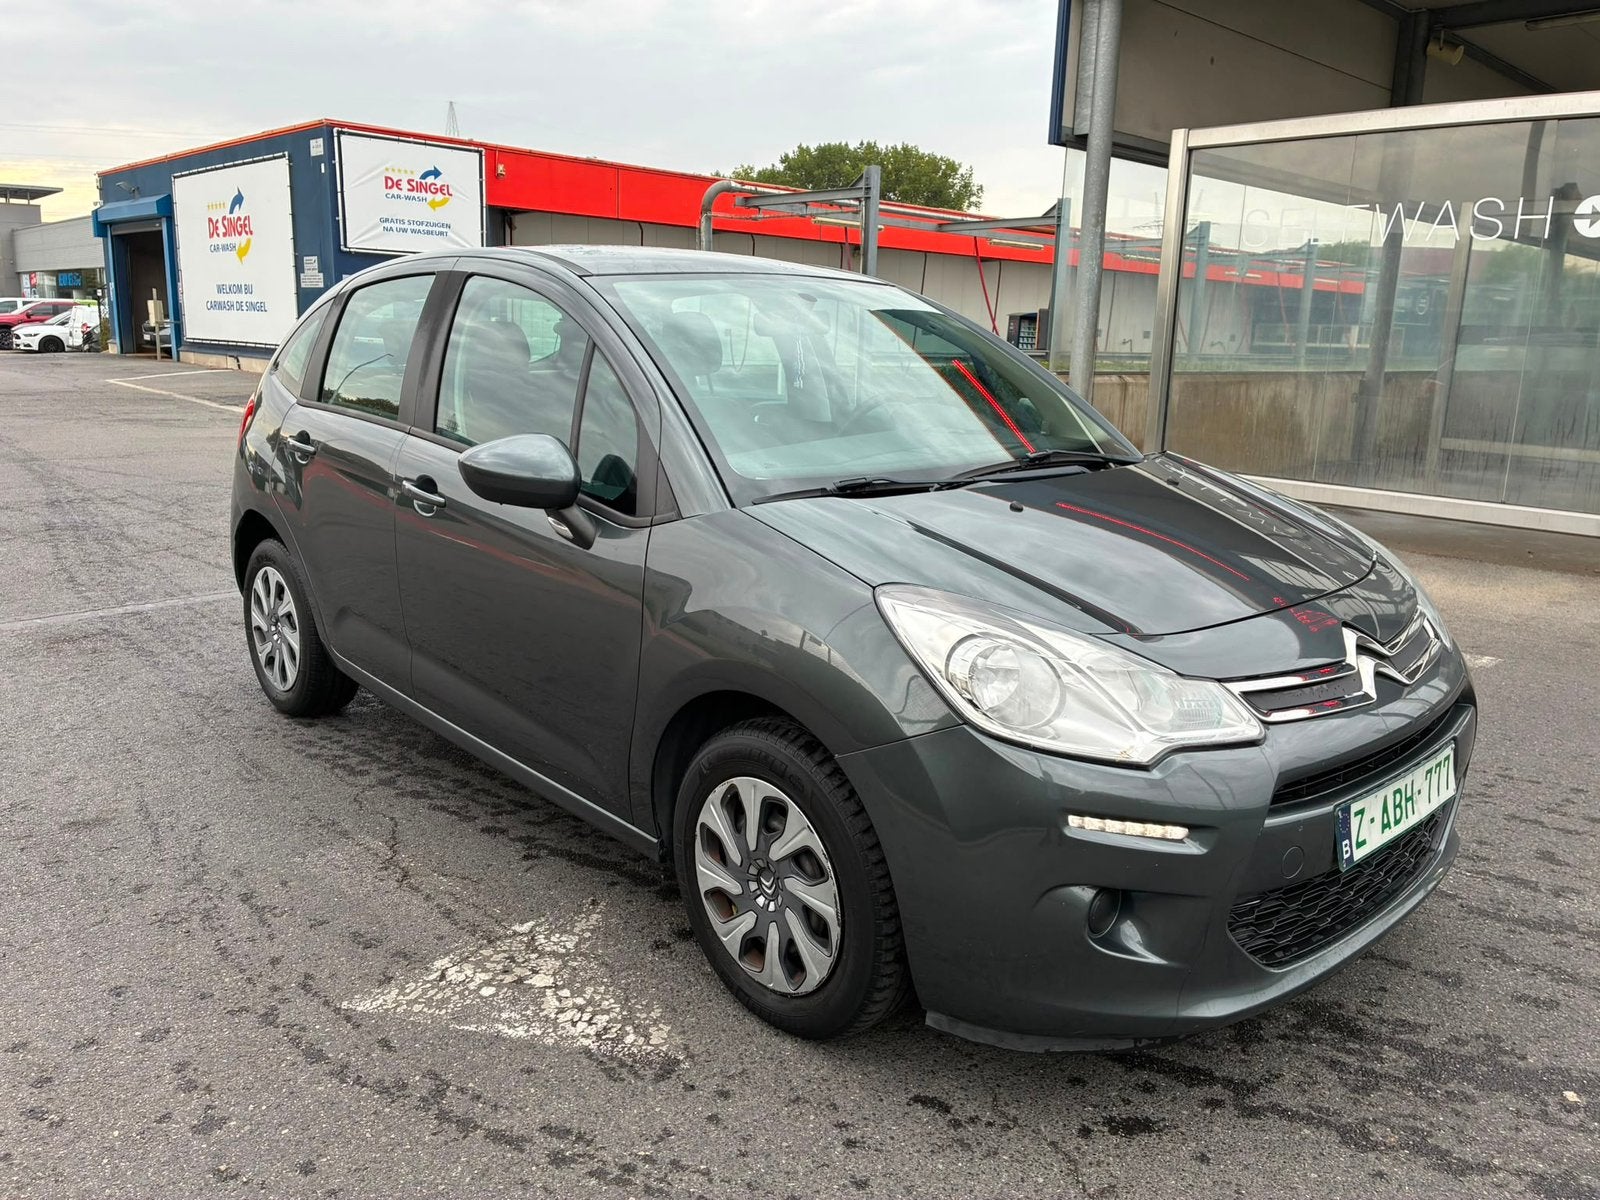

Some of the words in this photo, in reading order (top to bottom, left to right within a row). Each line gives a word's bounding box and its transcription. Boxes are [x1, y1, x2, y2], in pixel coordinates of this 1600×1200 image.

[384, 176, 403, 191] DE
[406, 178, 453, 197] SINGEL
[385, 192, 428, 203] CAR-WASH
[207, 216, 220, 239] DE
[221, 214, 254, 238] SINGEL
[379, 217, 406, 226] GRATIS
[406, 218, 451, 230] STOFZUIGEN
[382, 225, 394, 233] NA
[395, 226, 409, 235] UW
[409, 227, 449, 238] WASBEURT
[209, 242, 237, 253] CAR-WASH
[215, 283, 243, 295] WELKOM
[243, 283, 253, 296] BIJ
[205, 300, 235, 311] CARWASH
[235, 300, 244, 312] DE
[245, 301, 268, 313] SINGEL
[1353, 754, 1451, 851] Z-ABH-777
[1342, 839, 1351, 860] B
